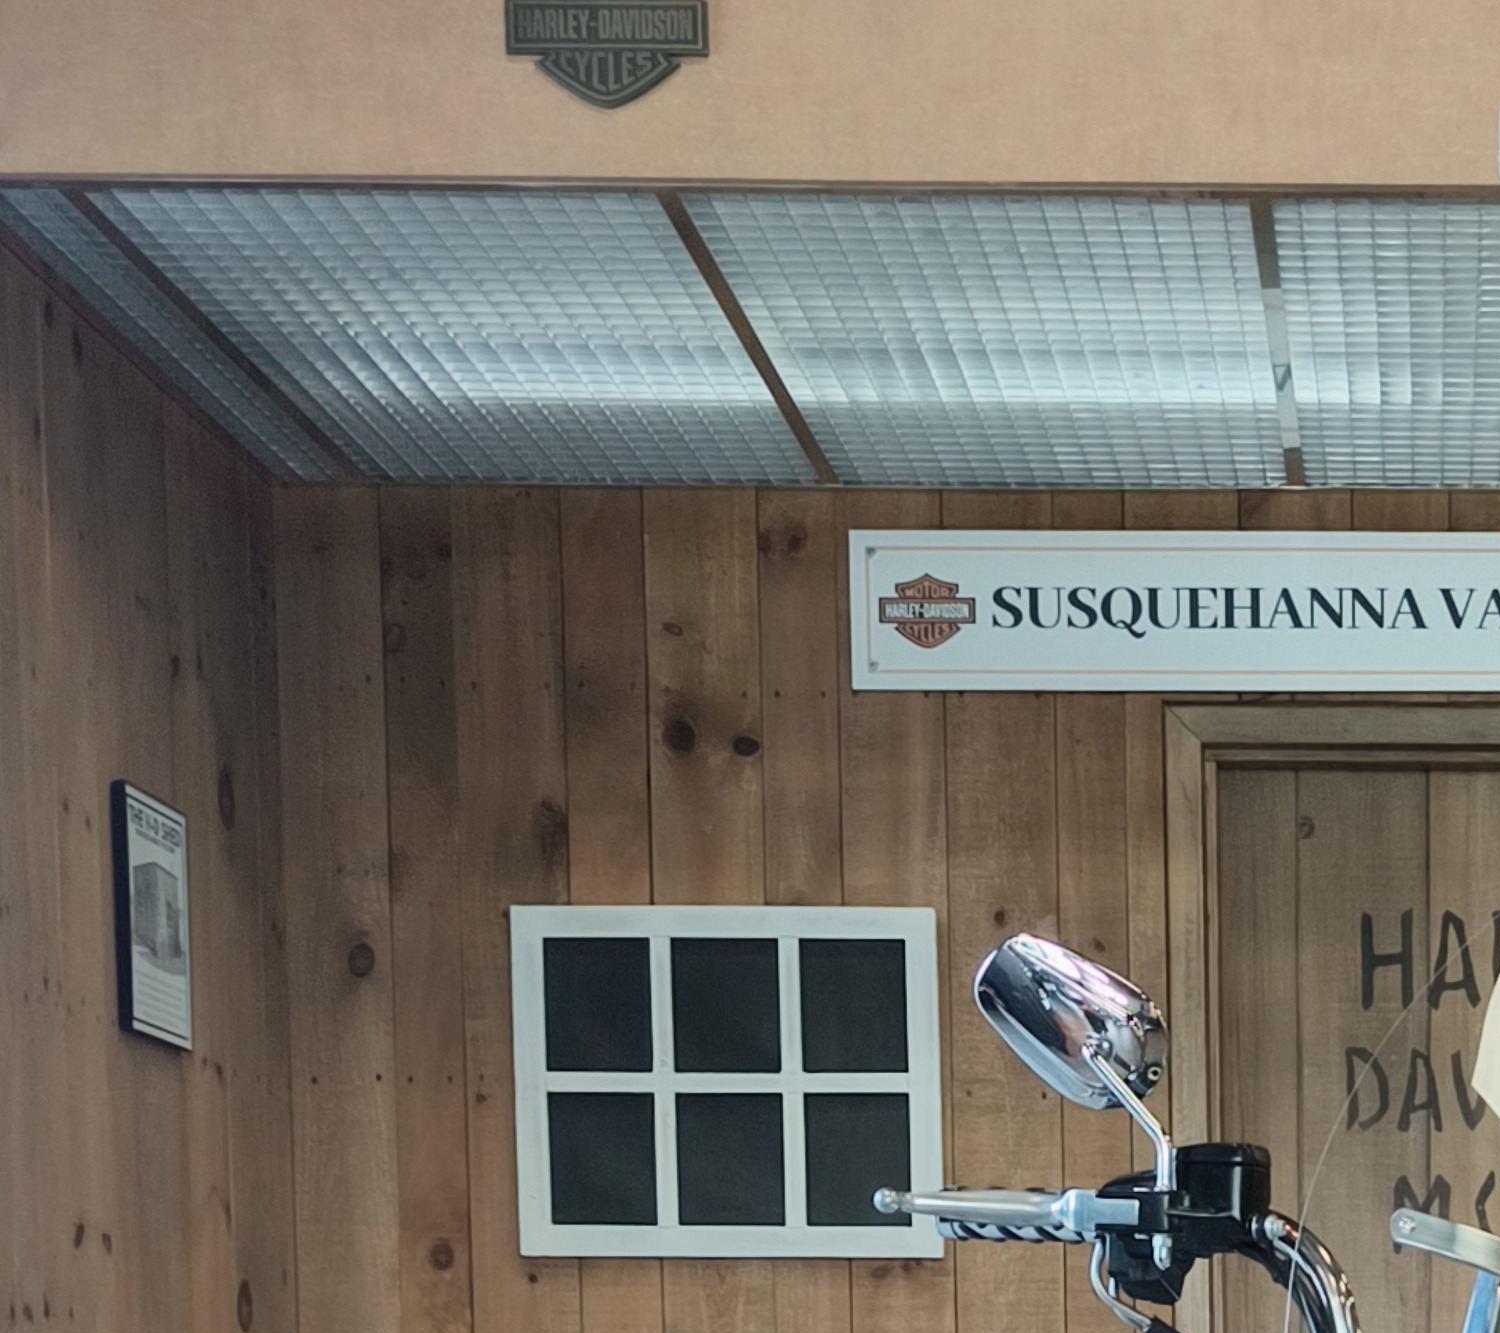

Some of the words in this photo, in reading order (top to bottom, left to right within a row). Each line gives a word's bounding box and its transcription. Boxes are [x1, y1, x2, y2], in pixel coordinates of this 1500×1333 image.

[517, 8, 693, 41] HARLEY-DAVIDSON
[559, 50, 652, 93] CYCLES
[904, 581, 950, 598] MOTOR
[991, 585, 1428, 639] SUSQUEHANNA
